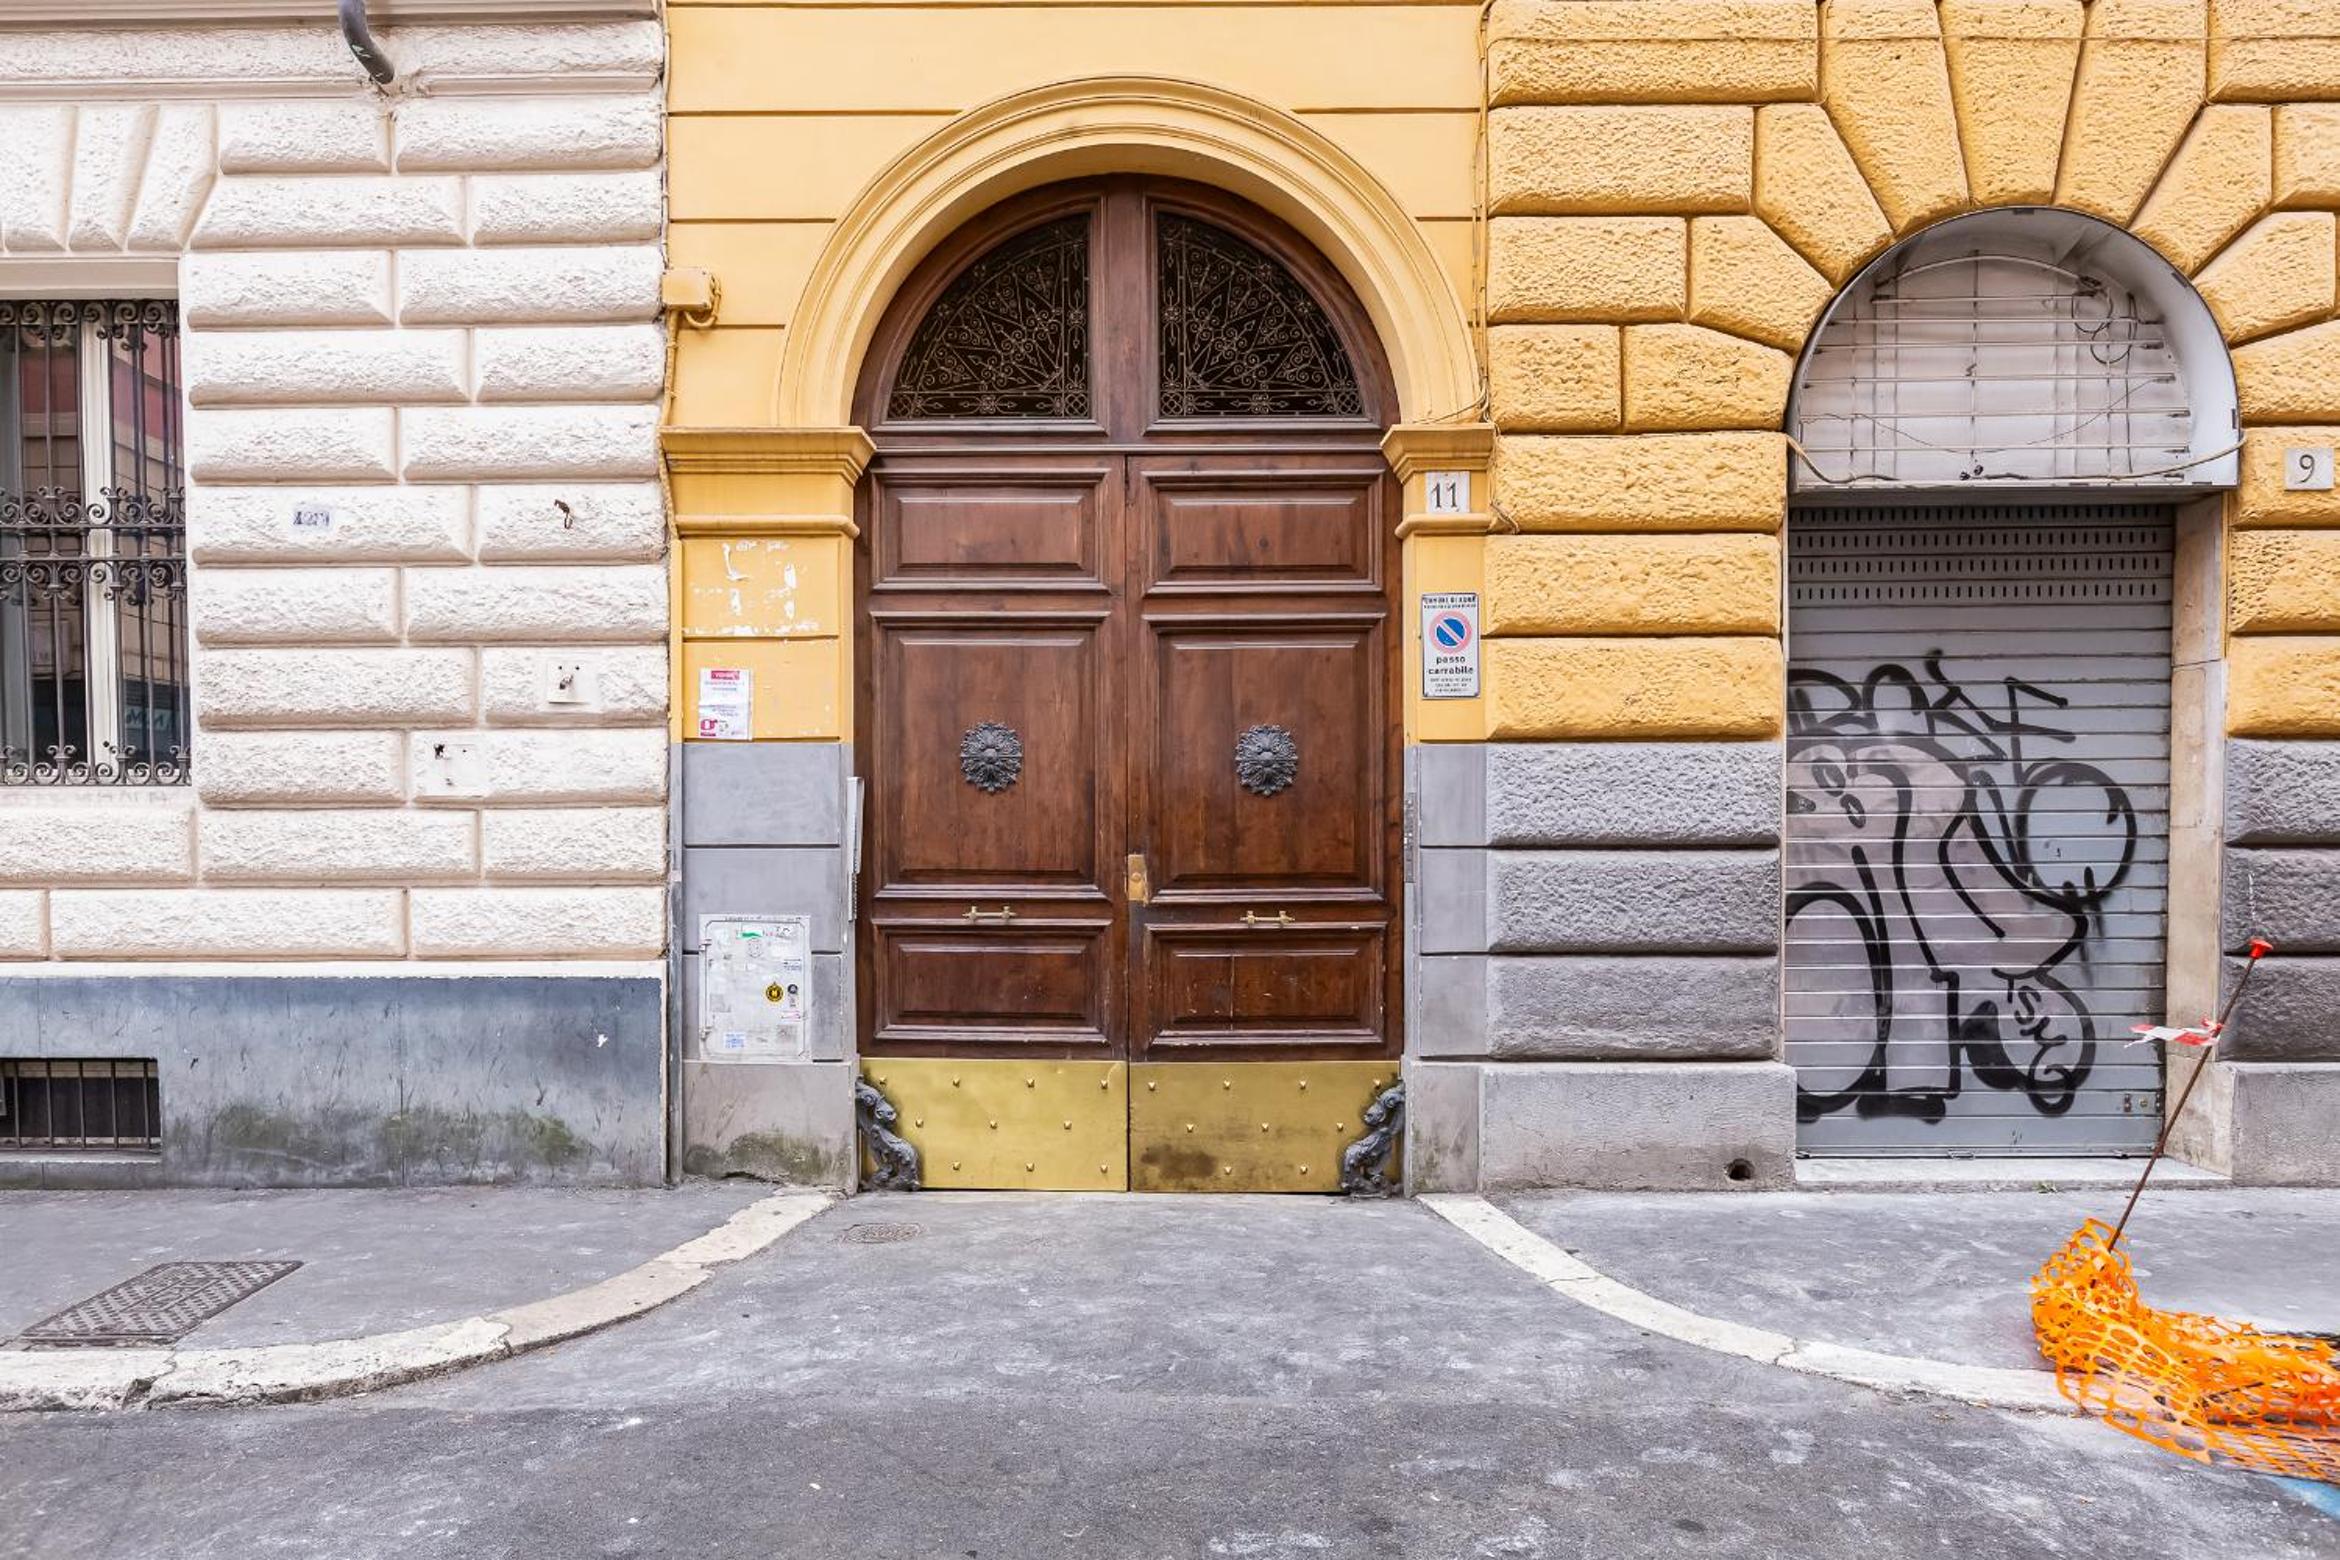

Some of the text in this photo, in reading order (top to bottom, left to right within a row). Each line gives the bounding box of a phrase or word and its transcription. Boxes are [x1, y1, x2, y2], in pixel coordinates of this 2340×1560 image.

[2295, 454, 2316, 484] 9
[1431, 481, 1458, 508] 11
[1436, 655, 1466, 665] passo
[1428, 665, 1474, 675] carrabile
